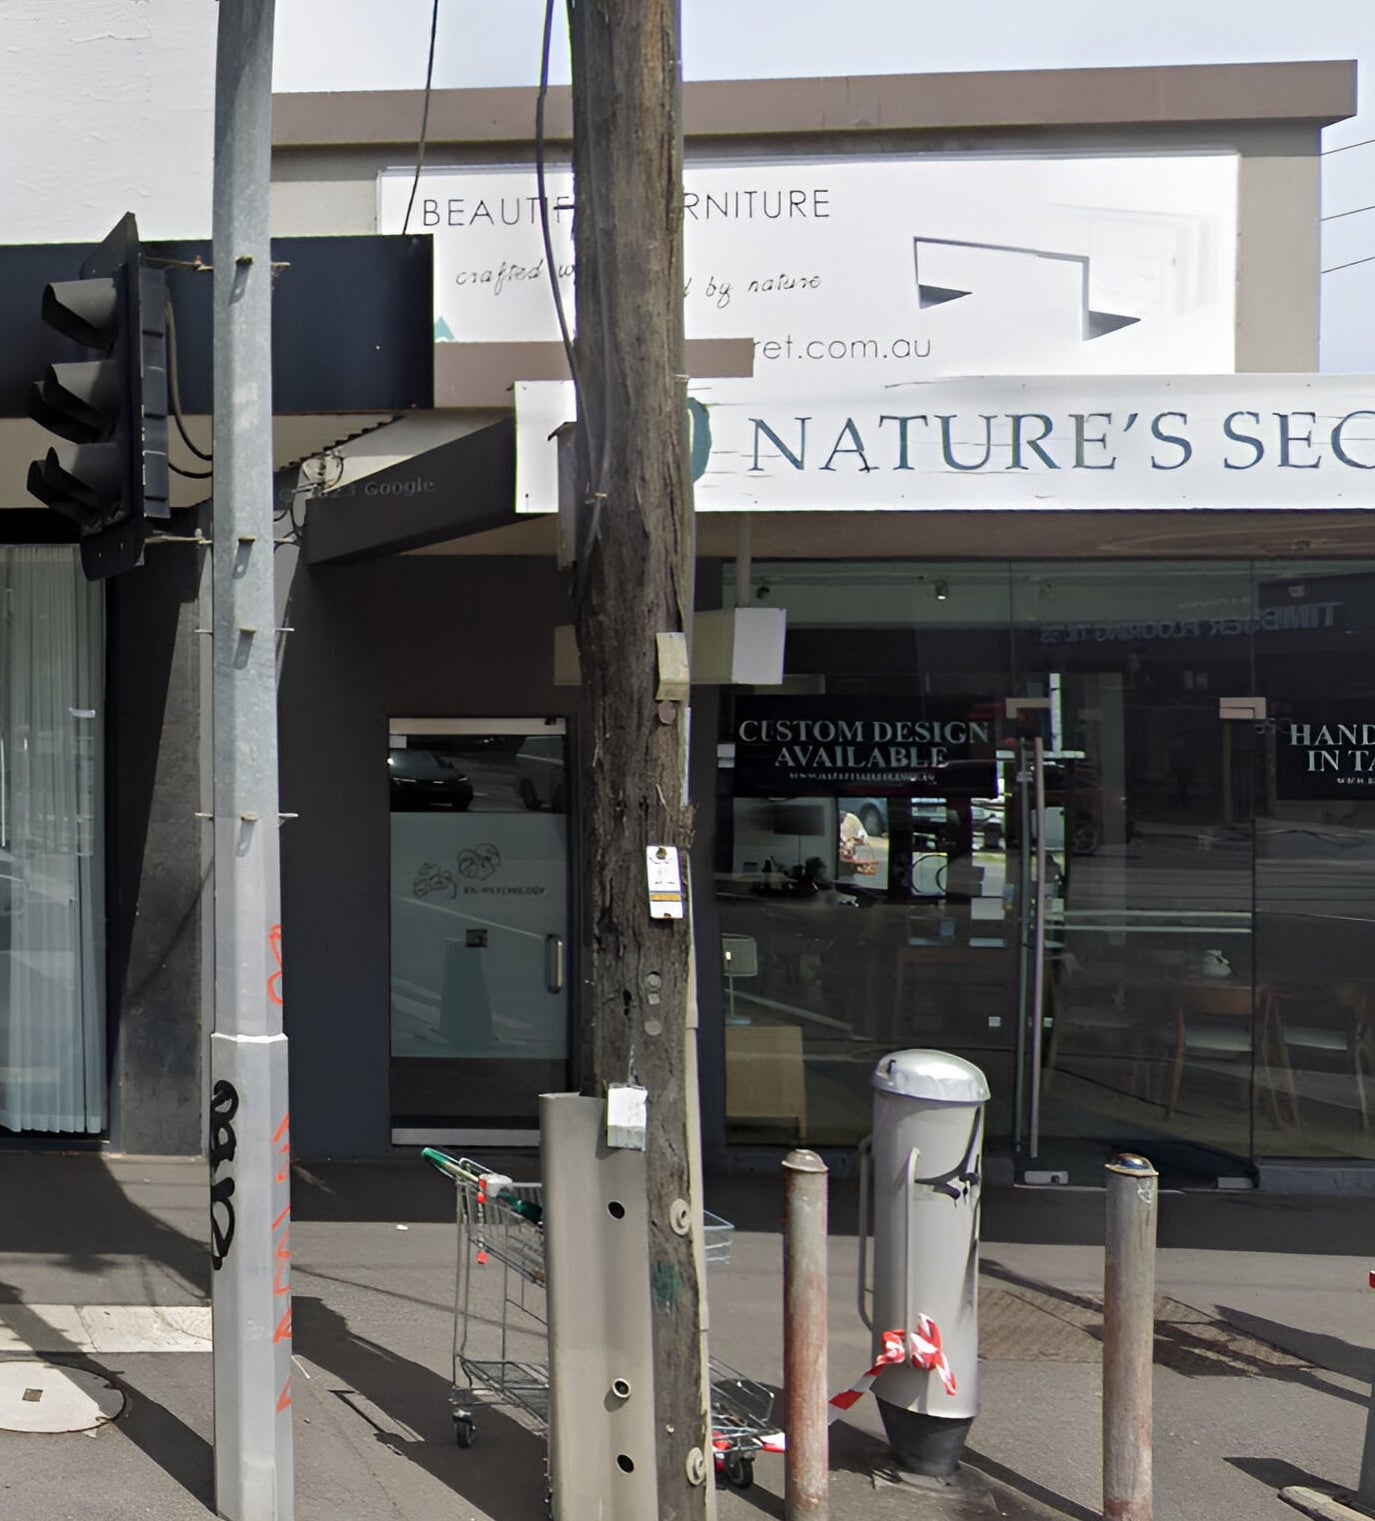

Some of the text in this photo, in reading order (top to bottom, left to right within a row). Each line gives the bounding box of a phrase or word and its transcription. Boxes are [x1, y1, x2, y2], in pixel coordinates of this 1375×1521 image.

[422, 189, 830, 227] BEAUTF RNITURE
[705, 275, 733, 309] by
[747, 273, 822, 293] nature
[873, 721, 990, 745] DESIGN
[774, 746, 950, 769] AVAILABLE
[1306, 749, 1340, 772] IN
